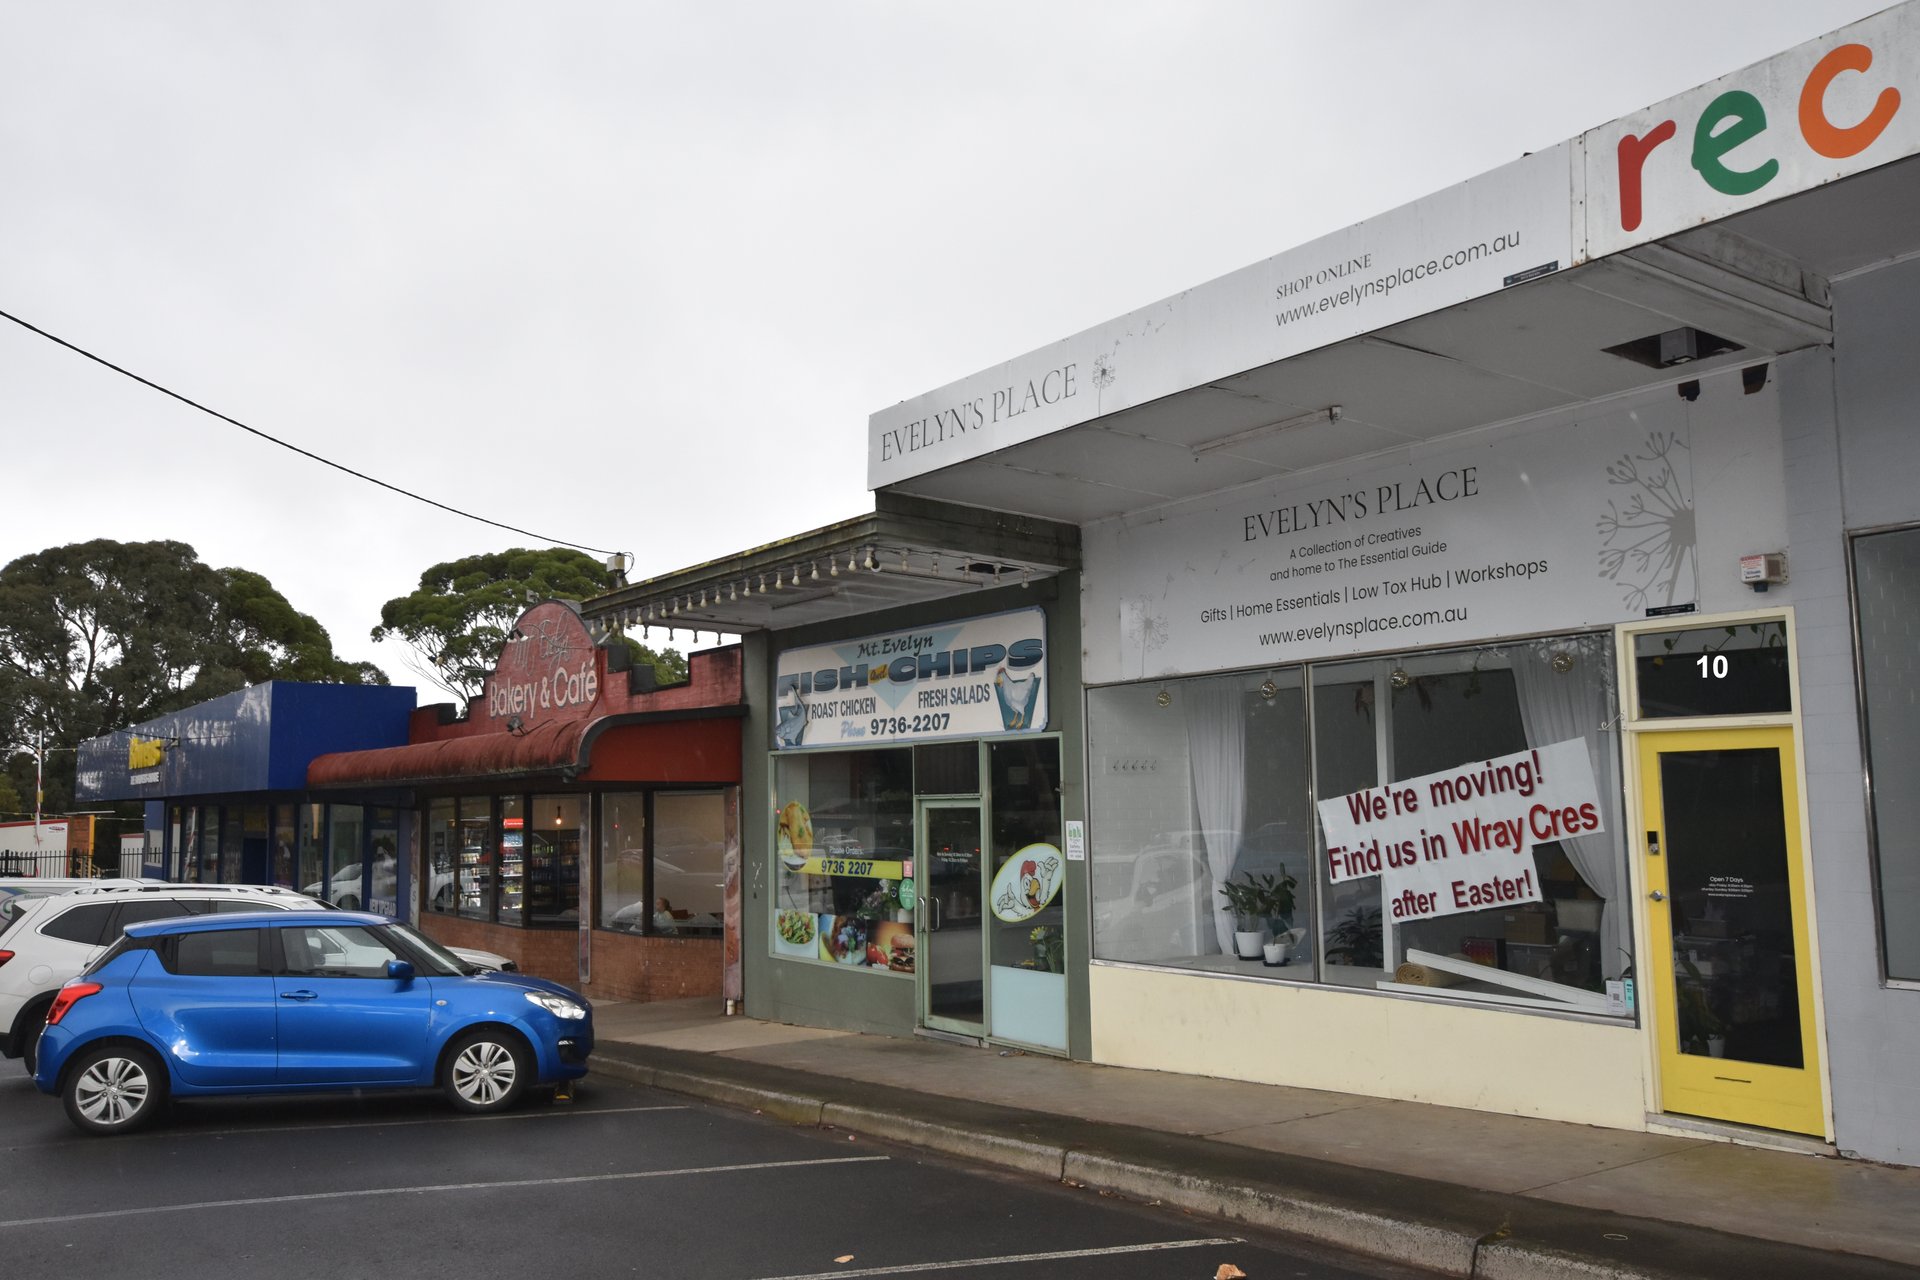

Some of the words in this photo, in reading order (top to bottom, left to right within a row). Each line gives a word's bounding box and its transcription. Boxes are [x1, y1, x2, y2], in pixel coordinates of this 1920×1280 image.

[1276, 275, 1313, 300] SHOP
[1316, 254, 1372, 285] ONLINE
[1276, 231, 1520, 326] www.evelynsplace.com.au
[881, 398, 984, 462] EVELYN'S
[991, 363, 1077, 424] PLACE
[1243, 491, 1367, 542] EVELYN'S
[1376, 467, 1479, 514] PLACE
[1270, 568, 1290, 581] and
[1292, 564, 1322, 578] home
[1324, 561, 1336, 572] to
[1338, 556, 1358, 570] The
[1360, 547, 1409, 566] Essential
[1412, 541, 1447, 557] Guide
[1289, 549, 1297, 560] A
[1299, 539, 1351, 558] Collection
[1354, 535, 1365, 548] of
[1367, 526, 1422, 545] Creatives
[1200, 608, 1227, 623] Gifts
[1237, 601, 1273, 618] Home
[1276, 589, 1341, 612] Essentials
[1352, 585, 1379, 601] Low
[1383, 581, 1407, 595] Tox
[1411, 574, 1442, 592] Hub
[1455, 560, 1548, 585] Workshops
[1259, 607, 1468, 646] www.evelynsplace.com.au
[490, 678, 537, 719] Bakery
[540, 676, 550, 709] &
[553, 657, 598, 707] Café
[777, 663, 869, 697] FISH
[887, 638, 1044, 684] CHIPS
[1696, 655, 1729, 680] 10
[811, 700, 838, 719] ROAST
[840, 697, 877, 717] CHICKEN
[918, 690, 948, 709] FRESH
[950, 683, 990, 705] SALADS
[870, 713, 950, 736] 9736-2207
[1346, 785, 1418, 825] We're
[1429, 749, 1543, 808] moving!
[1327, 839, 1382, 879] Find
[1387, 839, 1418, 869] us
[1421, 829, 1447, 861] in
[1452, 816, 1523, 855] Wray
[1529, 802, 1599, 841] Cres
[821, 859, 845, 873] 9736
[848, 861, 874, 875] 2207
[1391, 888, 1438, 918] after
[1451, 868, 1534, 909] Easter!
